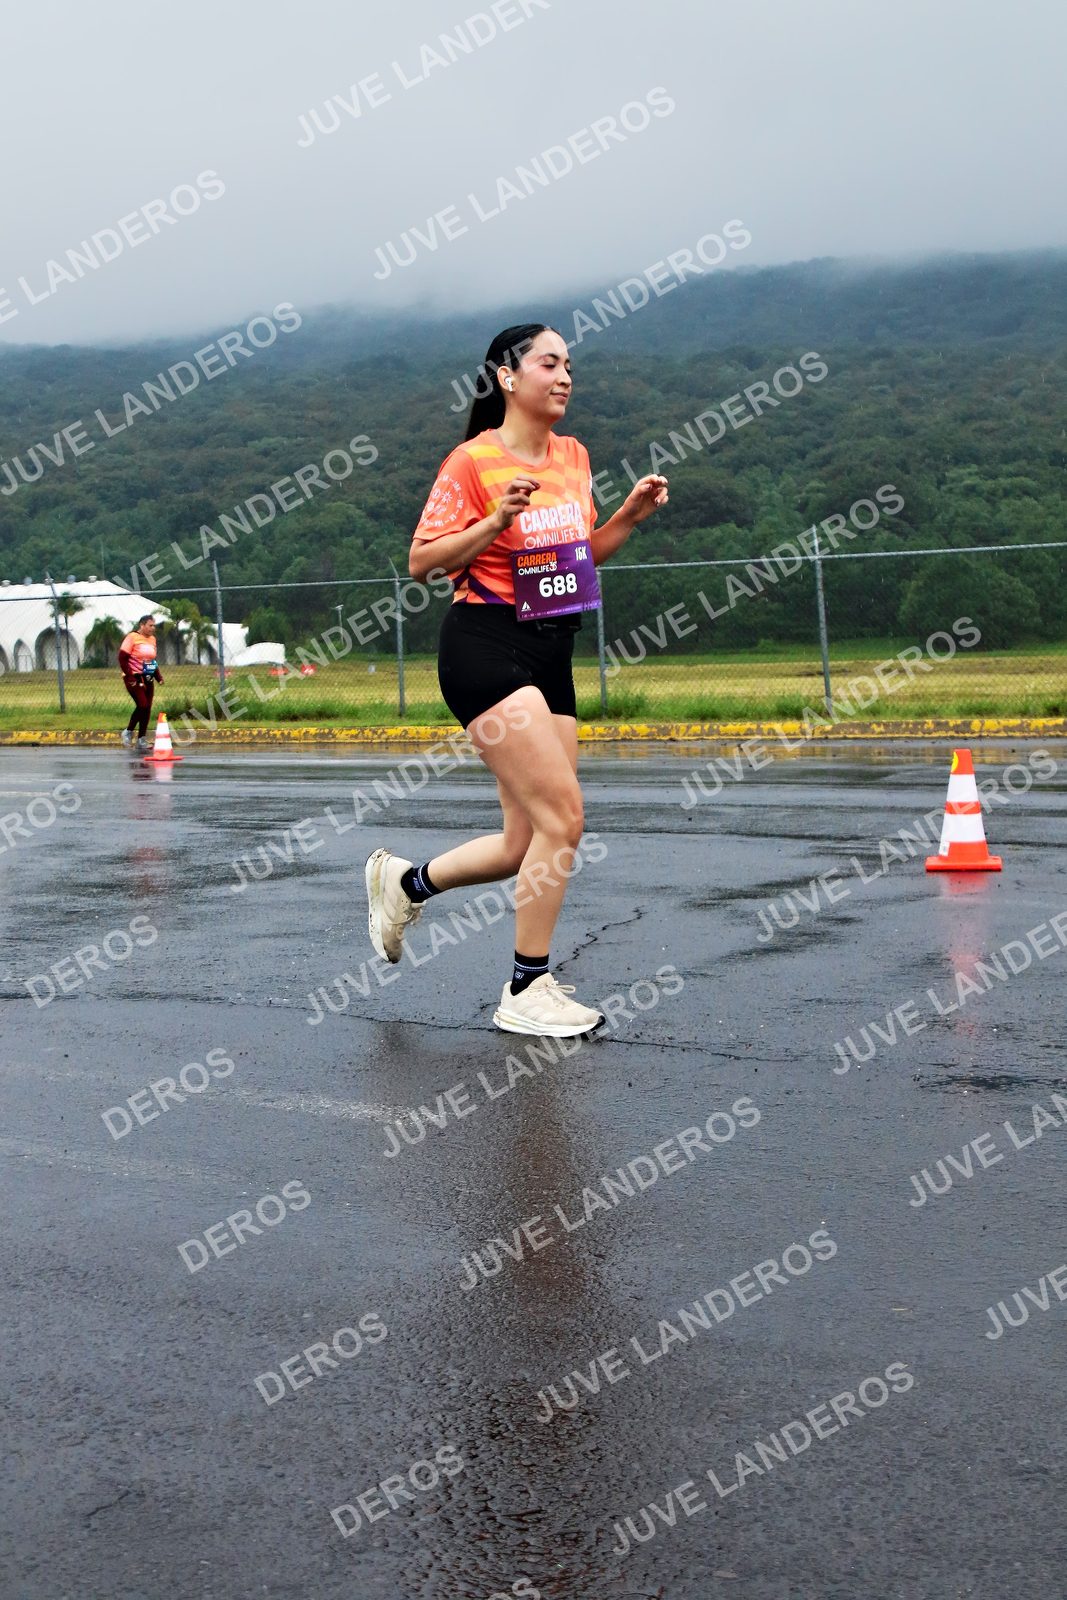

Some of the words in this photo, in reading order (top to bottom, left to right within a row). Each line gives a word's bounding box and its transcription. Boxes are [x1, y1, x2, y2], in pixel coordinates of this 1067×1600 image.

[520, 501, 584, 534] CARRERA
[517, 552, 557, 567] CARRERA
[539, 573, 577, 598] 688
